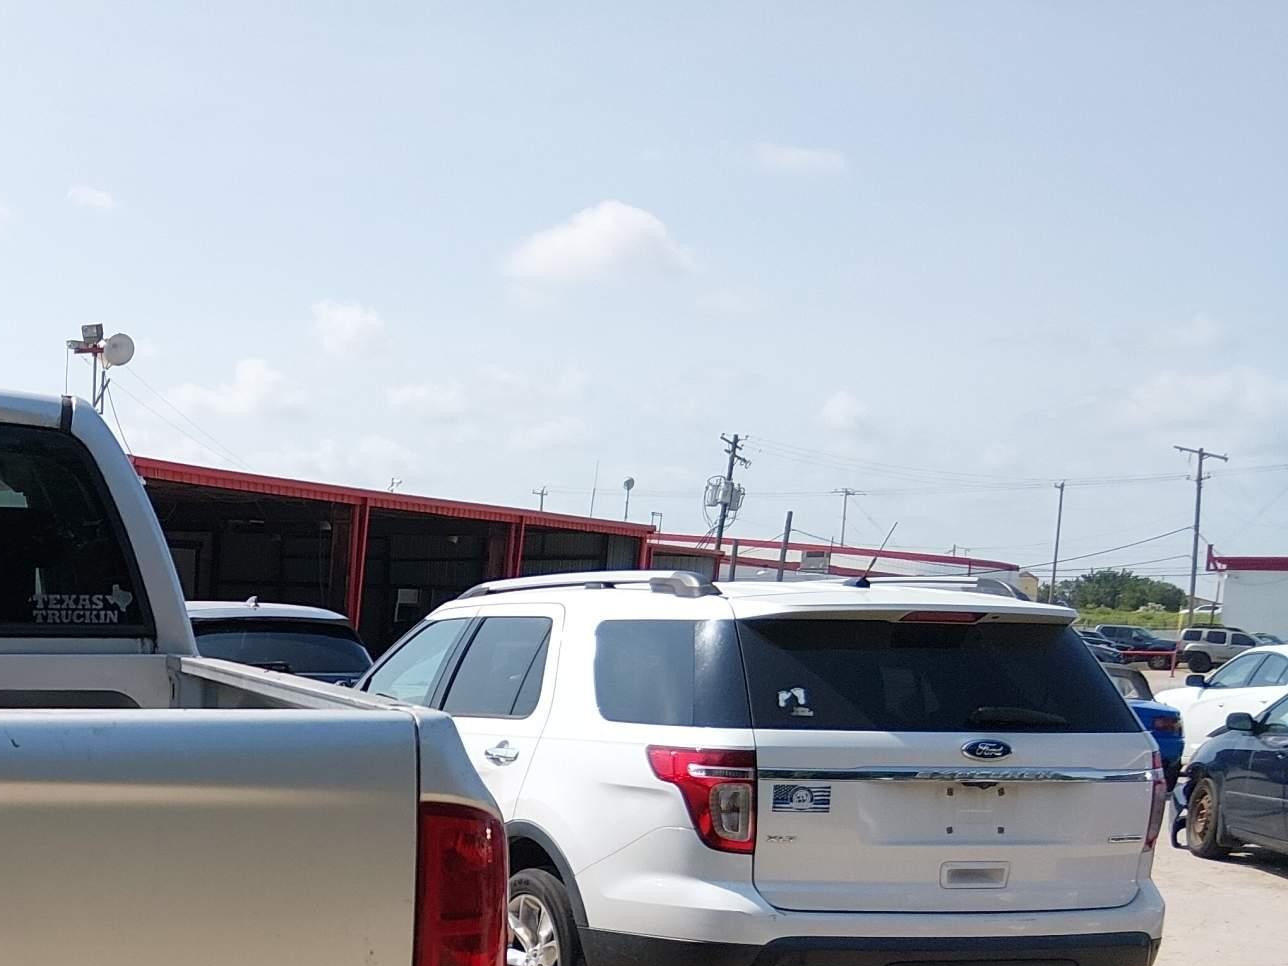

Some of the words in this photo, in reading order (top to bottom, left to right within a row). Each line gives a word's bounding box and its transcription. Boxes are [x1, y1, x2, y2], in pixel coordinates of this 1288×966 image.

[32, 594, 104, 609] TEXAS
[32, 610, 119, 624] TRUCKIN
[975, 742, 1004, 756] Ford
